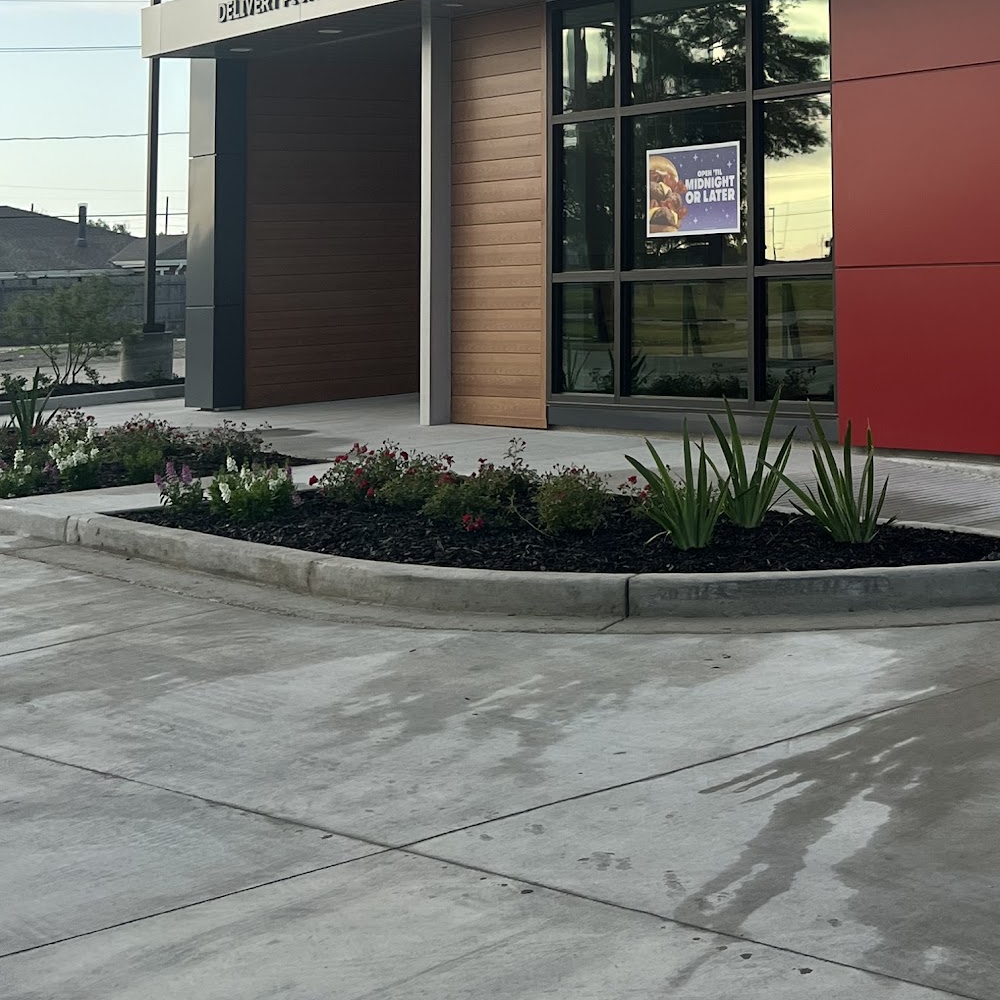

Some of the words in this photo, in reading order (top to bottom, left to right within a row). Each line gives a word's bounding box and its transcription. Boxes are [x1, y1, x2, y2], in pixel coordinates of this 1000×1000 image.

[697, 169, 712, 177] OPEN
[685, 174, 735, 190] MIDNIGHT
[685, 190, 701, 204] OR
[703, 188, 736, 203] LATER
